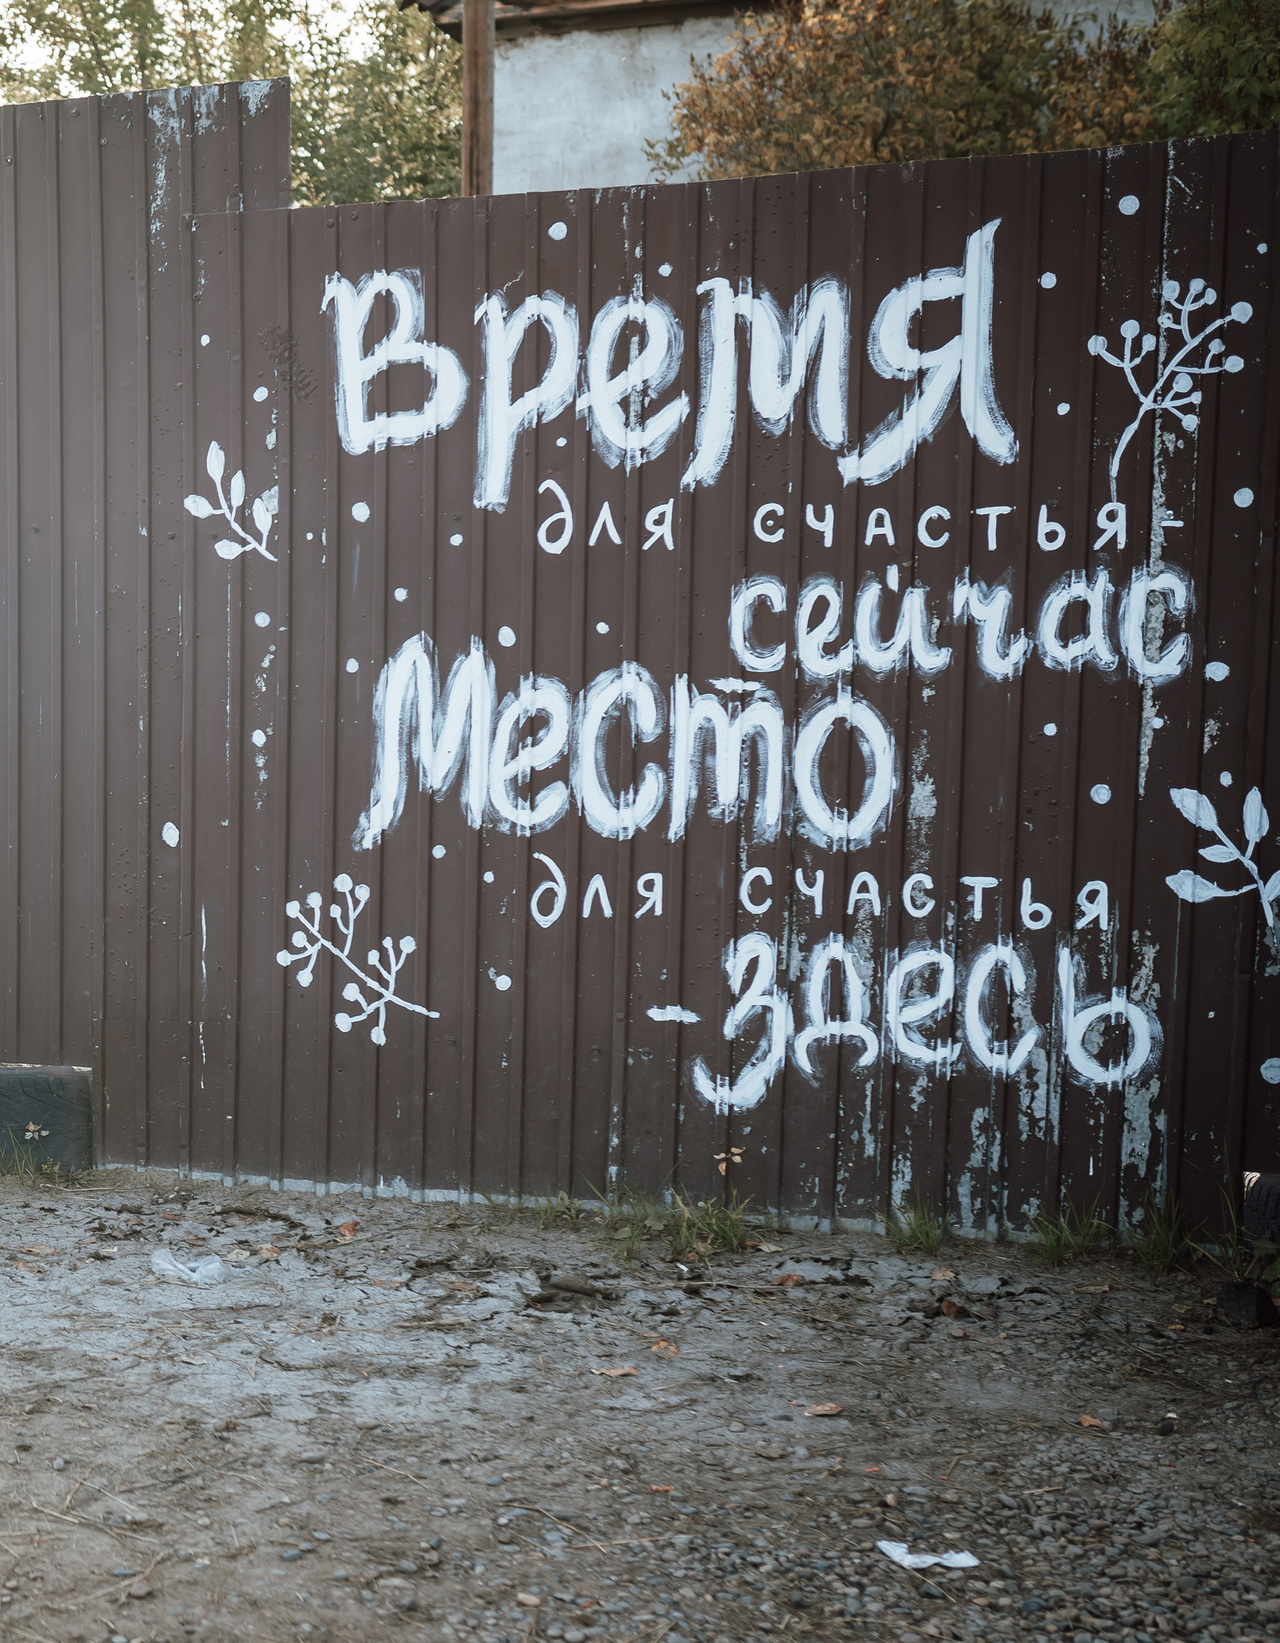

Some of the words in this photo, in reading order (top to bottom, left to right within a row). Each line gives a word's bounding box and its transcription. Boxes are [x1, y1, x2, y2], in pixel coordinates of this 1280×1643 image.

[321, 218, 1019, 512] Время
[538, 480, 676, 555] для
[728, 564, 1195, 682] сейчас
[352, 630, 900, 852] Место
[530, 852, 665, 928] для
[740, 867, 1110, 931] счастья
